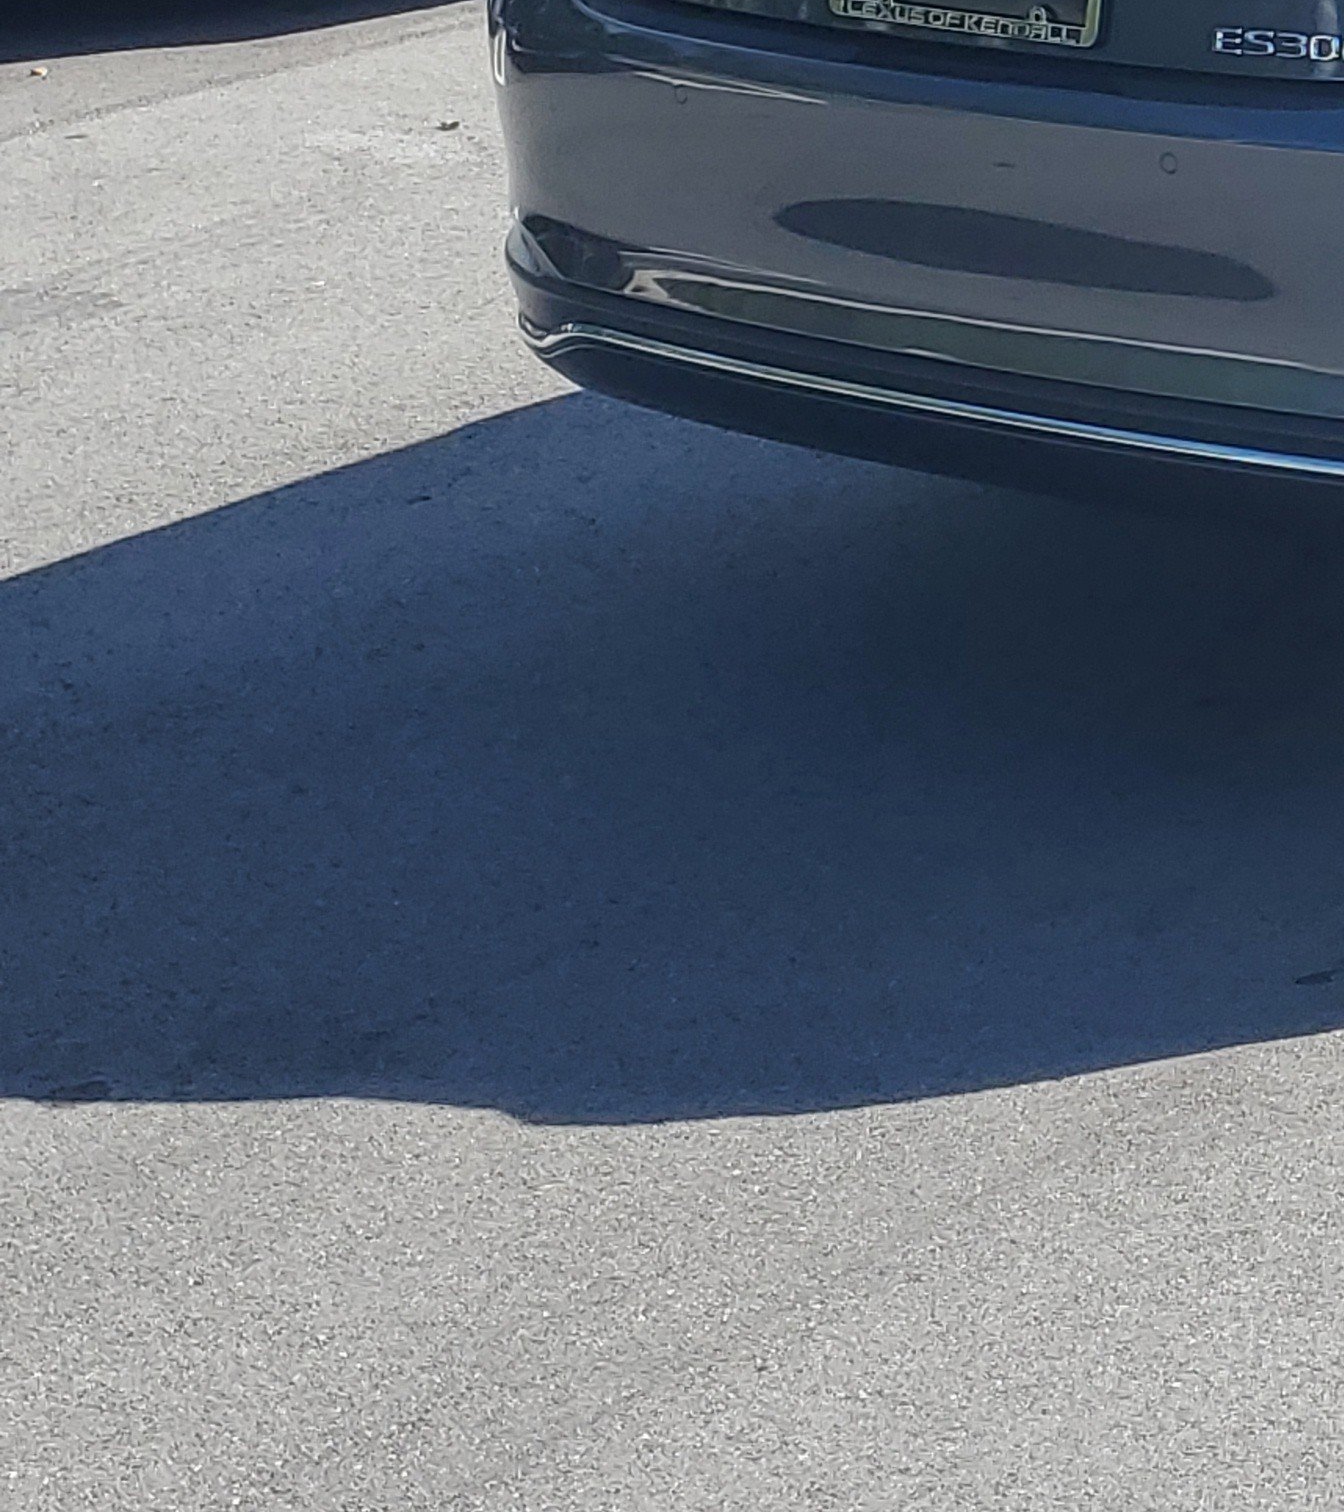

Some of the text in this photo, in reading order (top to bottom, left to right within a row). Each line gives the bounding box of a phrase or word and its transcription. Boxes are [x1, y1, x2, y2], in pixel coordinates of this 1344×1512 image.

[848, 0, 1081, 44] LEXUS OF KENDALL
